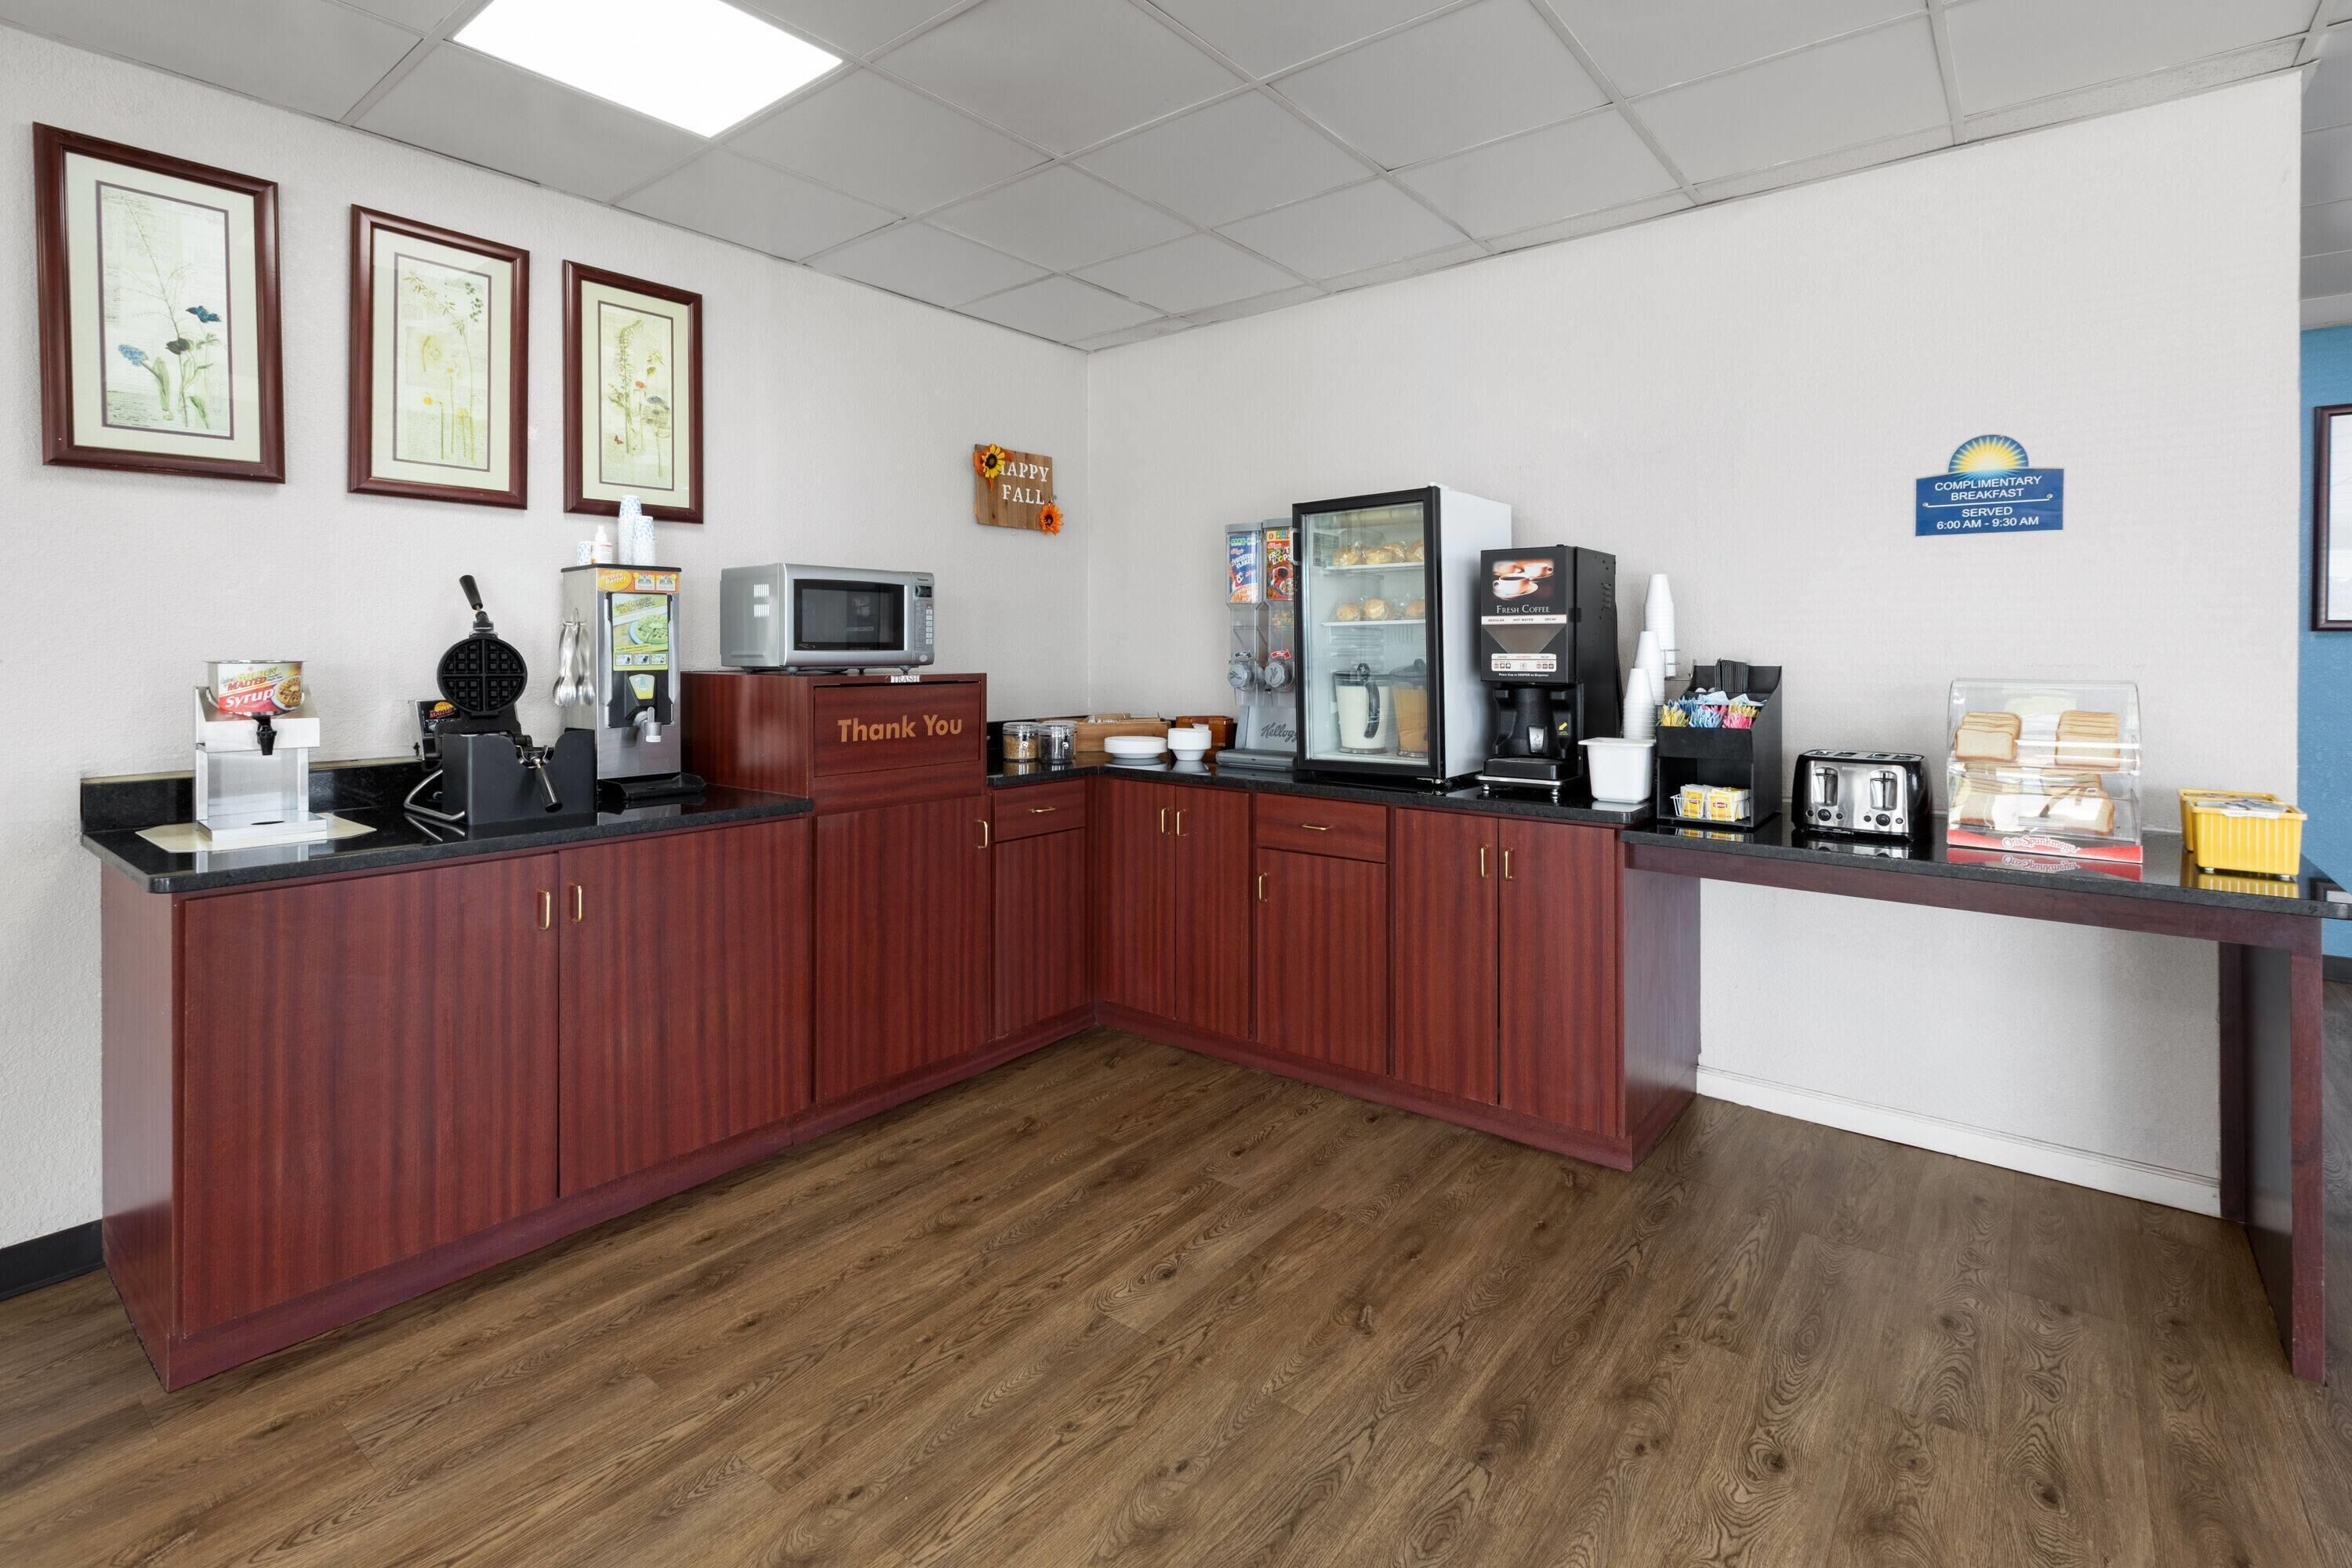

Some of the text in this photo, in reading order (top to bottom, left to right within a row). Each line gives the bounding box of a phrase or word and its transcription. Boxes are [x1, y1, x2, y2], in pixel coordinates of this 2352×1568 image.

[1934, 475, 2043, 492] COMPLIMENTARY
[1002, 484, 1045, 505] FALL
[1951, 488, 2024, 501] BREAKFAST
[1962, 506, 2013, 517] SERVED
[1936, 520, 1960, 530] 6:00
[1962, 519, 1982, 528] AM
[1992, 517, 2017, 527] 9:30
[2019, 516, 2039, 526] AM
[1497, 604, 1550, 613] FRESH COFFEE
[227, 677, 267, 691] MALTED
[225, 688, 274, 708] Syrup
[837, 715, 962, 742] Thank You
[2002, 835, 2080, 854] Otis Spunkmeyer
